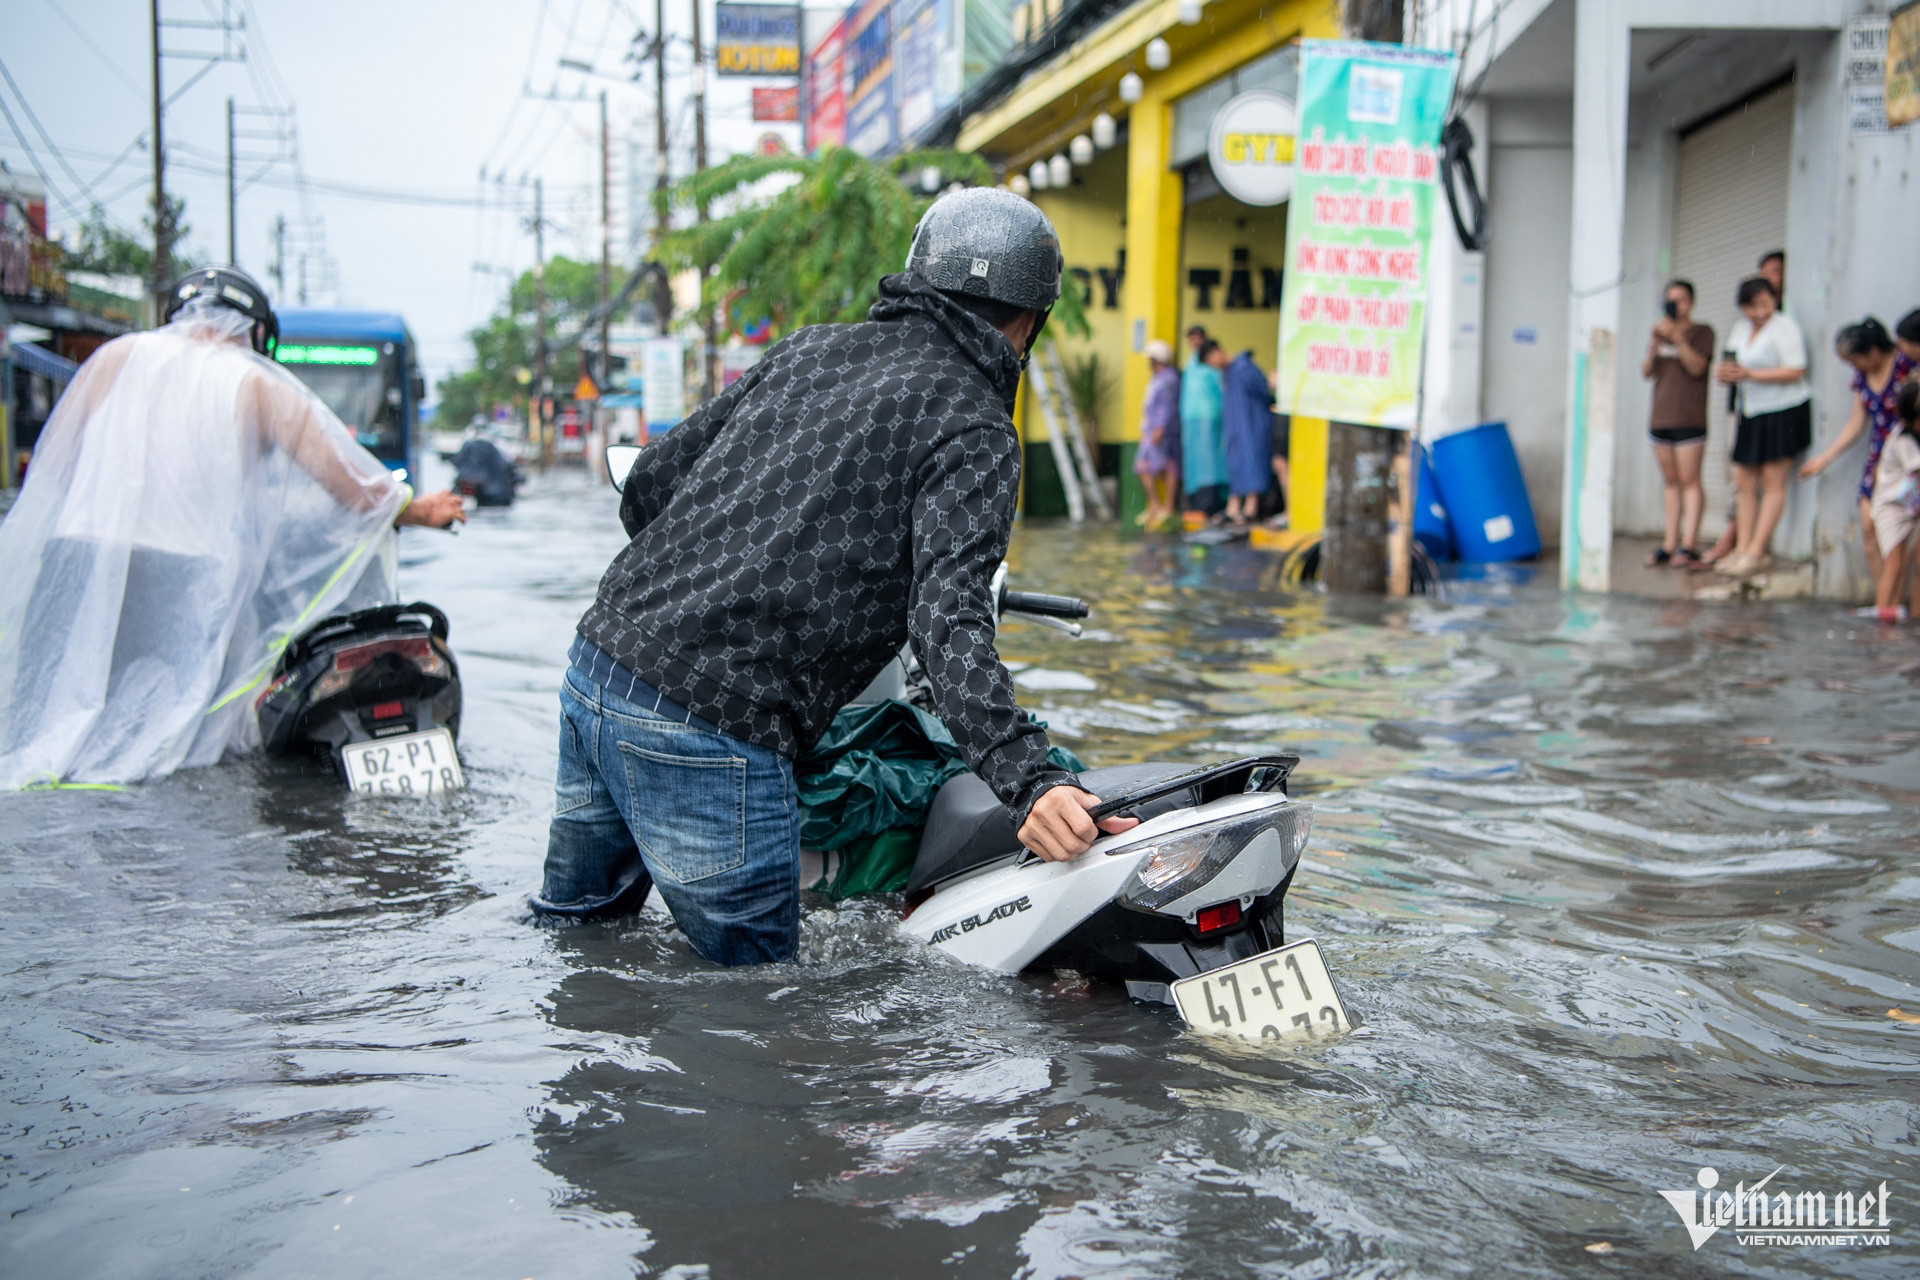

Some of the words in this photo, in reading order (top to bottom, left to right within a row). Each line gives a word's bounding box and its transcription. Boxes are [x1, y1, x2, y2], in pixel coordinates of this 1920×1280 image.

[362, 740, 436, 776] 62-P1
[927, 923, 960, 945] AIR
[961, 895, 1032, 932] BLADE
[1203, 954, 1312, 1027] 47-F1
